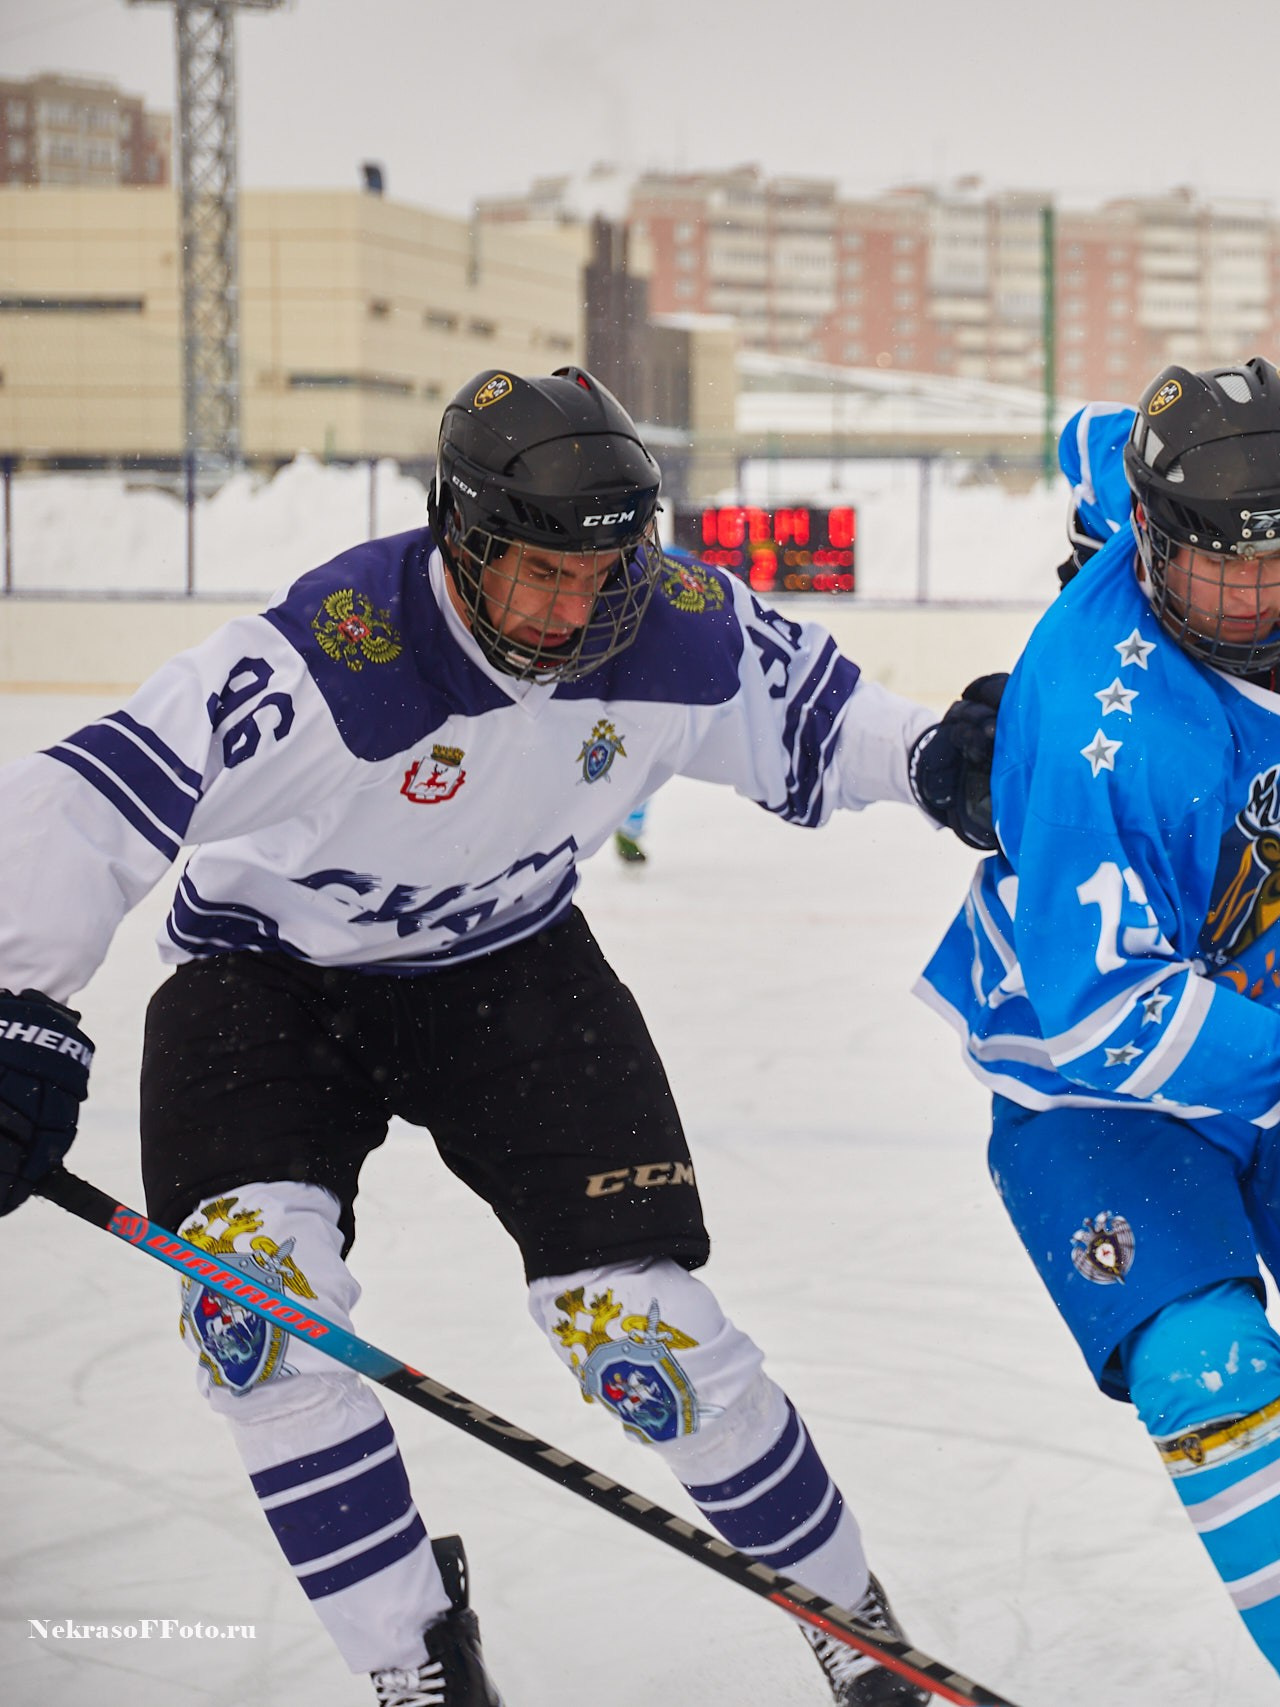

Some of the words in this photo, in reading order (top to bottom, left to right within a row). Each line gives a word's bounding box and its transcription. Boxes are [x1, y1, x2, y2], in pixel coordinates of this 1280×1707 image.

[452, 474, 478, 498] CCM
[583, 510, 636, 529] CCM
[206, 656, 296, 769] 96
[585, 1161, 696, 1198] CCM
[146, 1235, 330, 1339] WARRIOR
